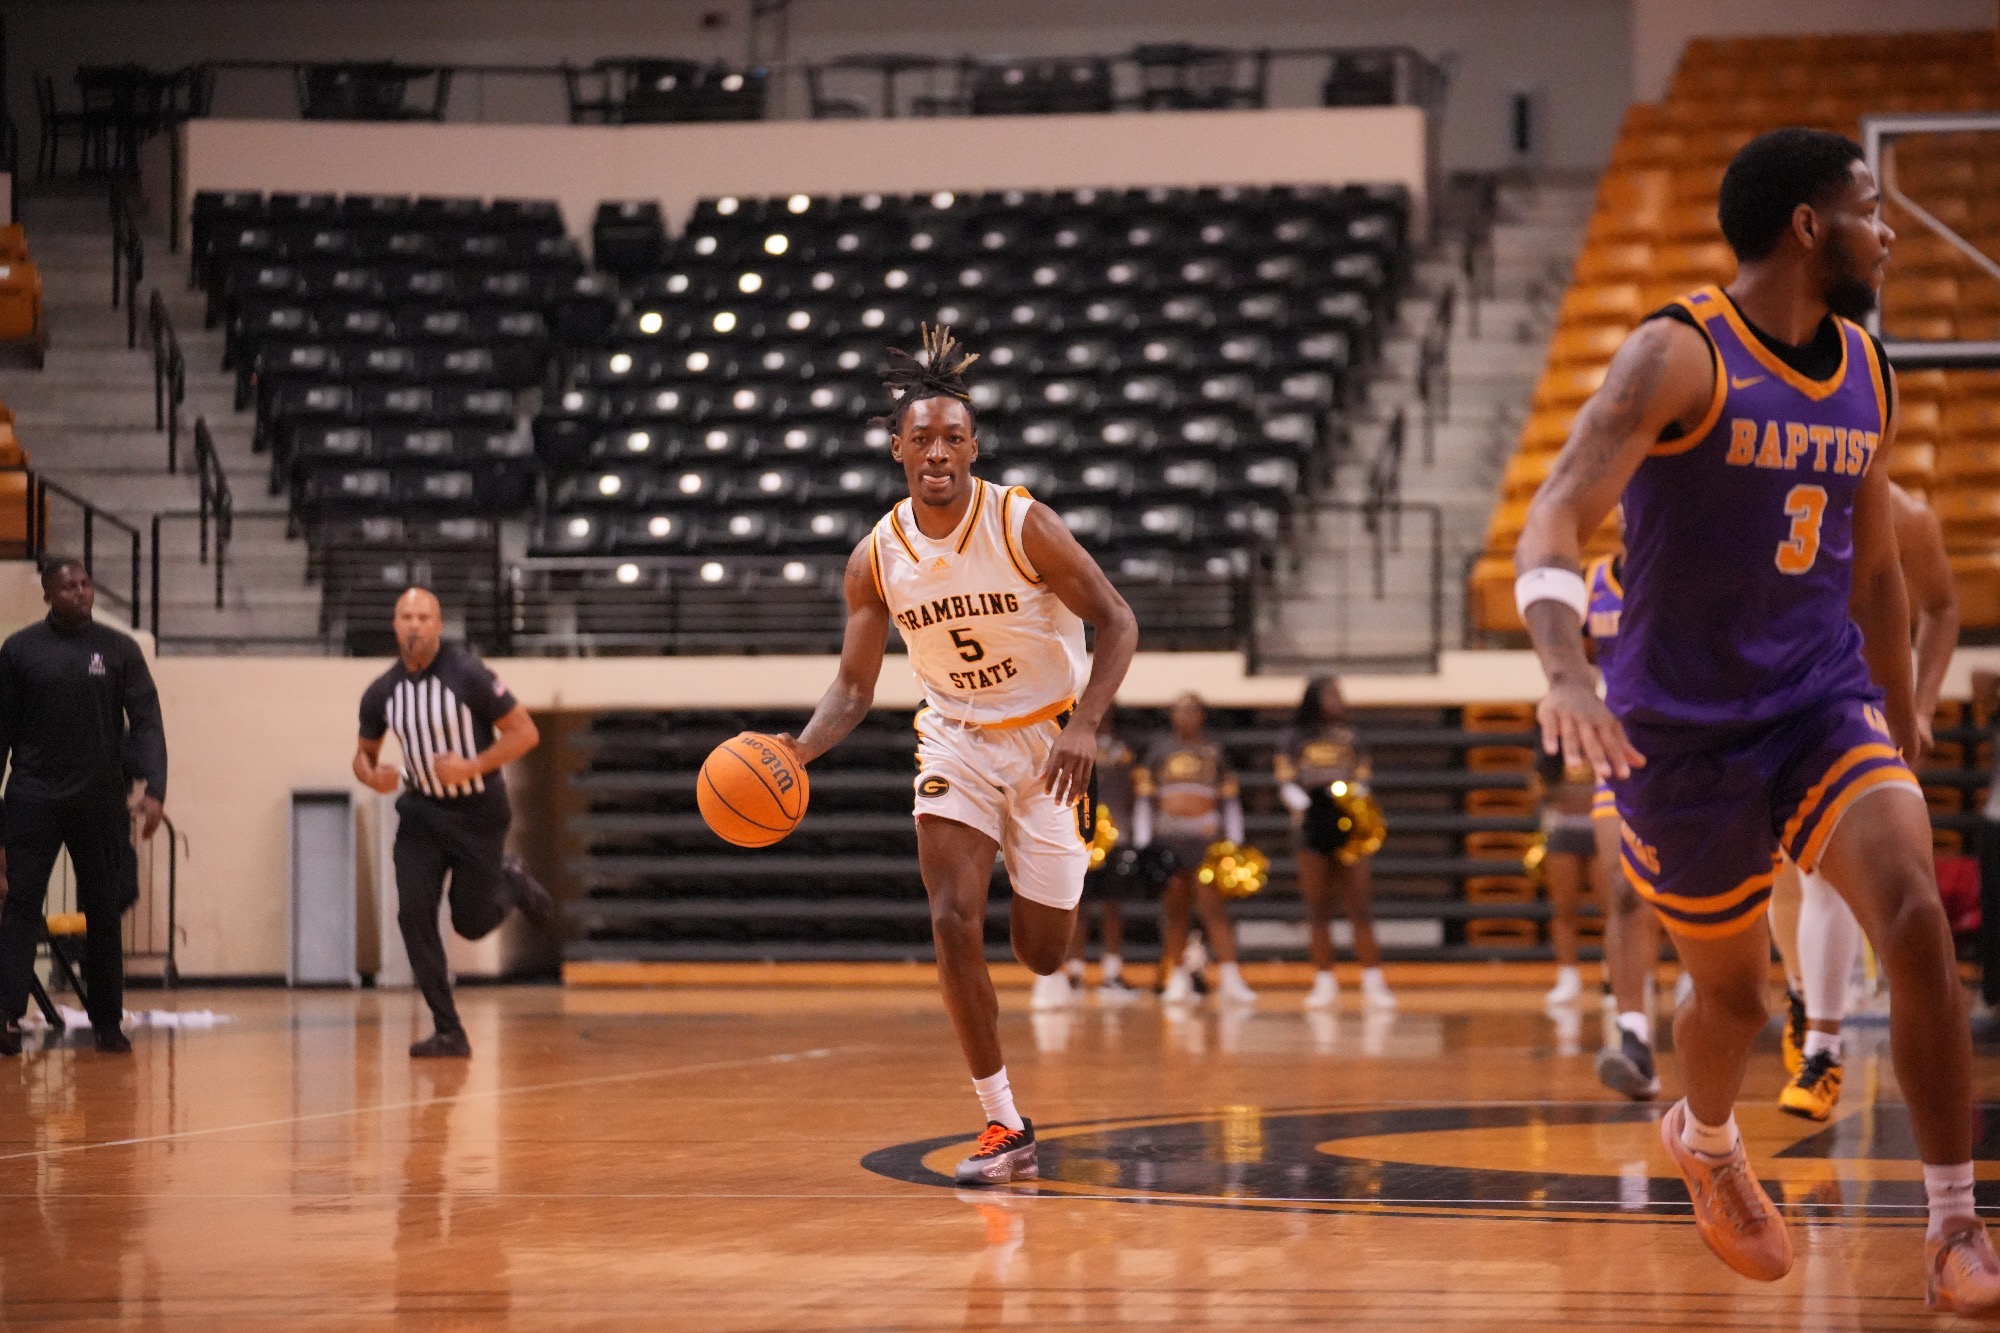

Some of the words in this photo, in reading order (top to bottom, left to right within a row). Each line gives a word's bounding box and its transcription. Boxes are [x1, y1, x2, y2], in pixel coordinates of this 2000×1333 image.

[1775, 484, 1828, 575] 3
[948, 627, 985, 662] 5
[949, 657, 1017, 690] STATE
[741, 738, 794, 794] Wilson
[920, 778, 949, 796] G
